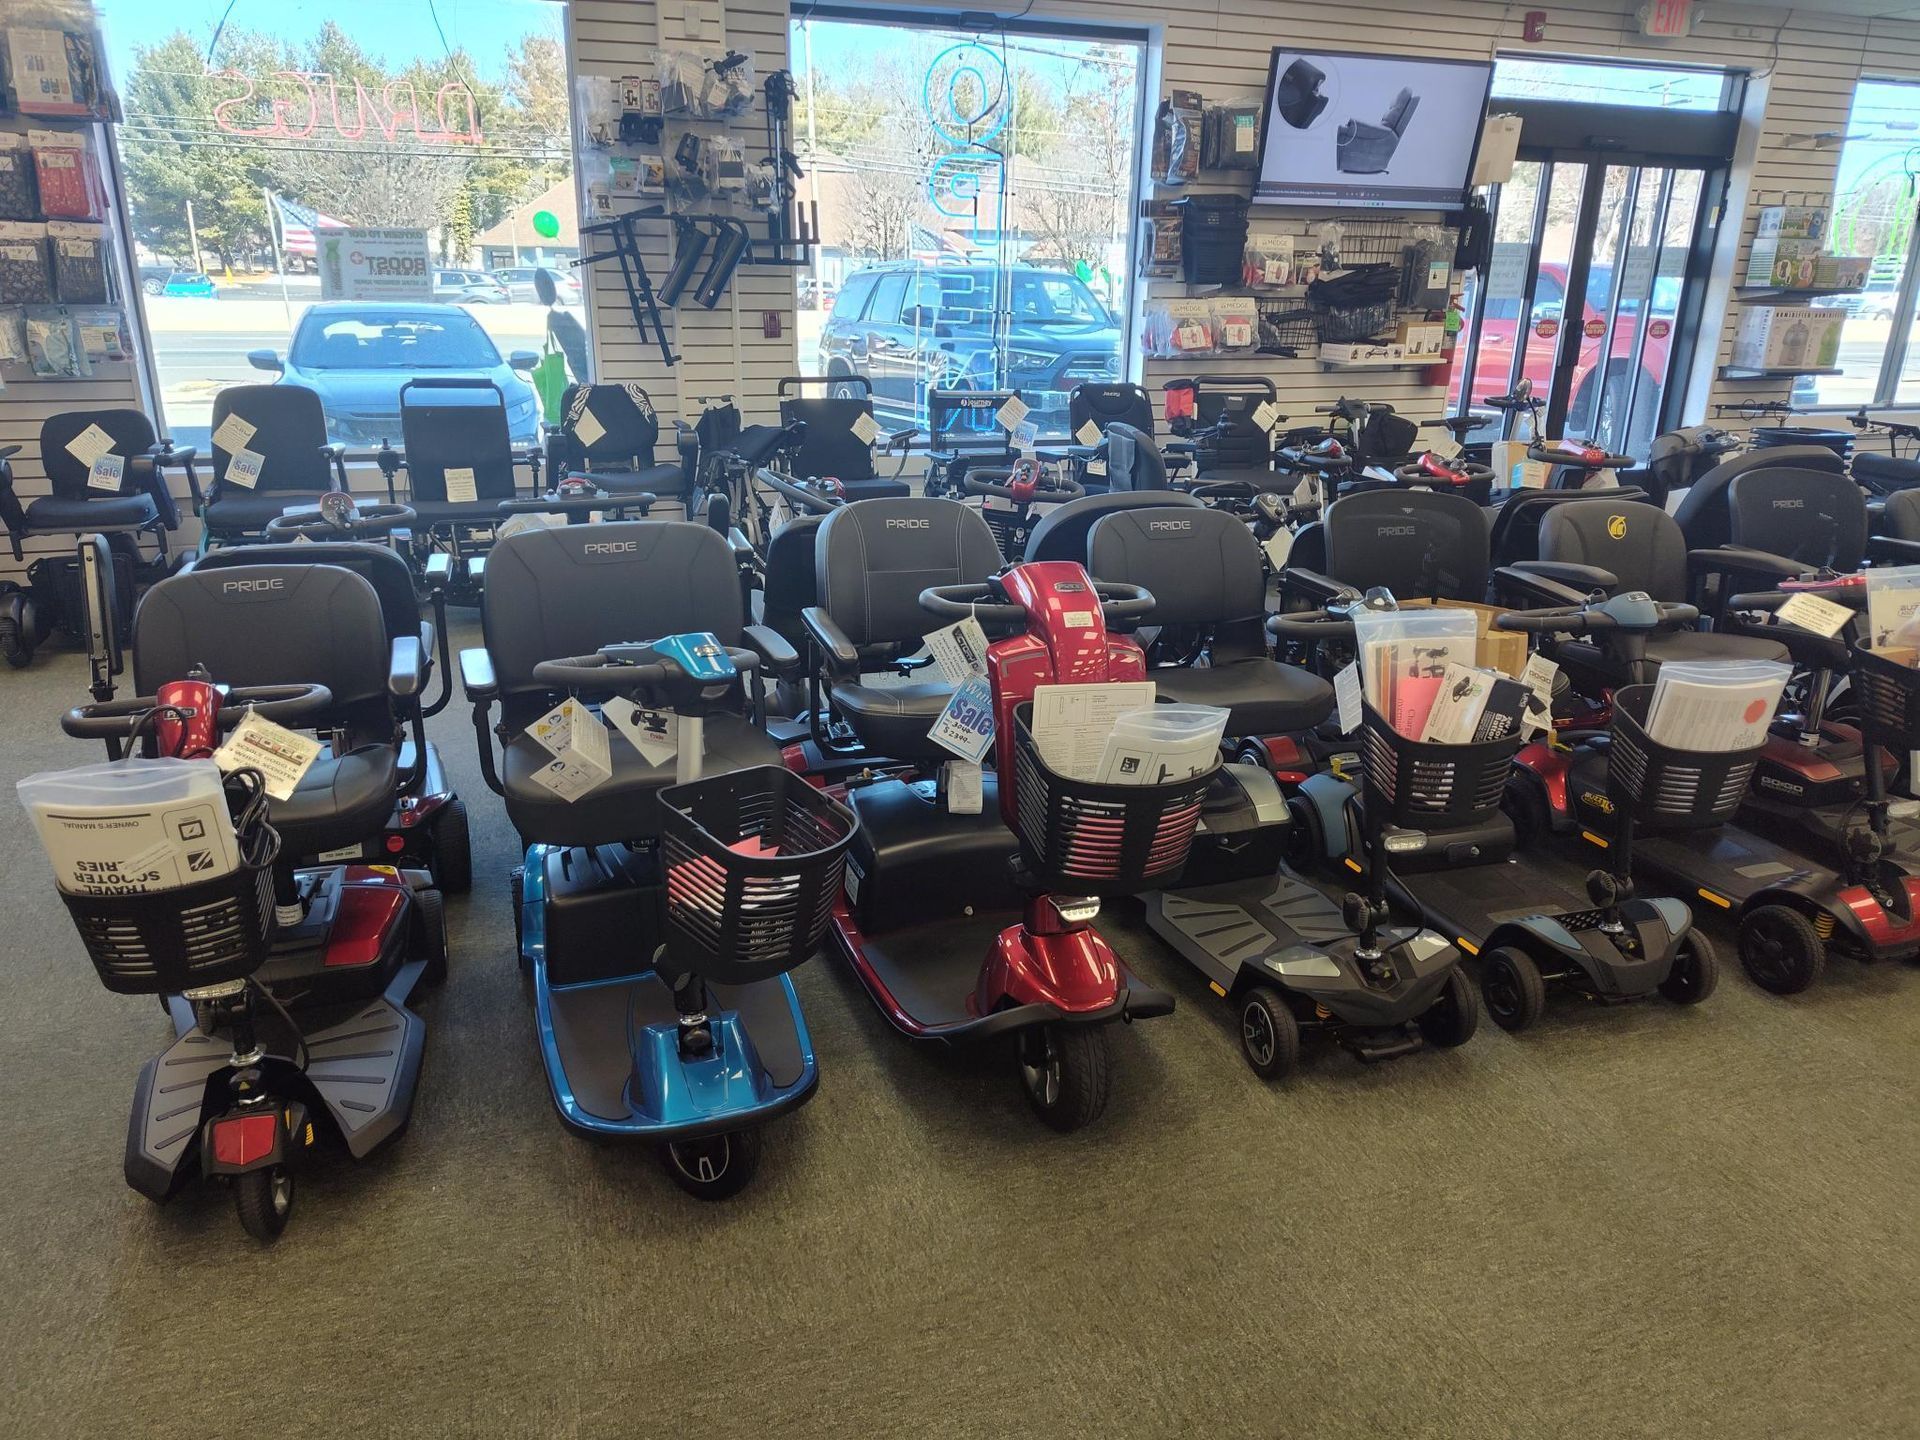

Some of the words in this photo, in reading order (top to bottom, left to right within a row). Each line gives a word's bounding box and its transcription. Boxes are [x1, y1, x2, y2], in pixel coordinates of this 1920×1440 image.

[1654, 0, 1685, 33] EXIT
[94, 464, 120, 479] Sale
[233, 457, 258, 477] Sale
[1772, 499, 1804, 508] PRIDE
[885, 519, 930, 529] PRIDE
[1150, 520, 1192, 531] PRIDE
[1377, 525, 1416, 537] PRIDE
[583, 541, 637, 555] PRIDE
[223, 578, 284, 593] PRIDE
[949, 696, 994, 737] Sale
[61, 821, 98, 831] MANUAL
[99, 821, 140, 830] OWNER'S
[76, 859, 126, 872] RIES
